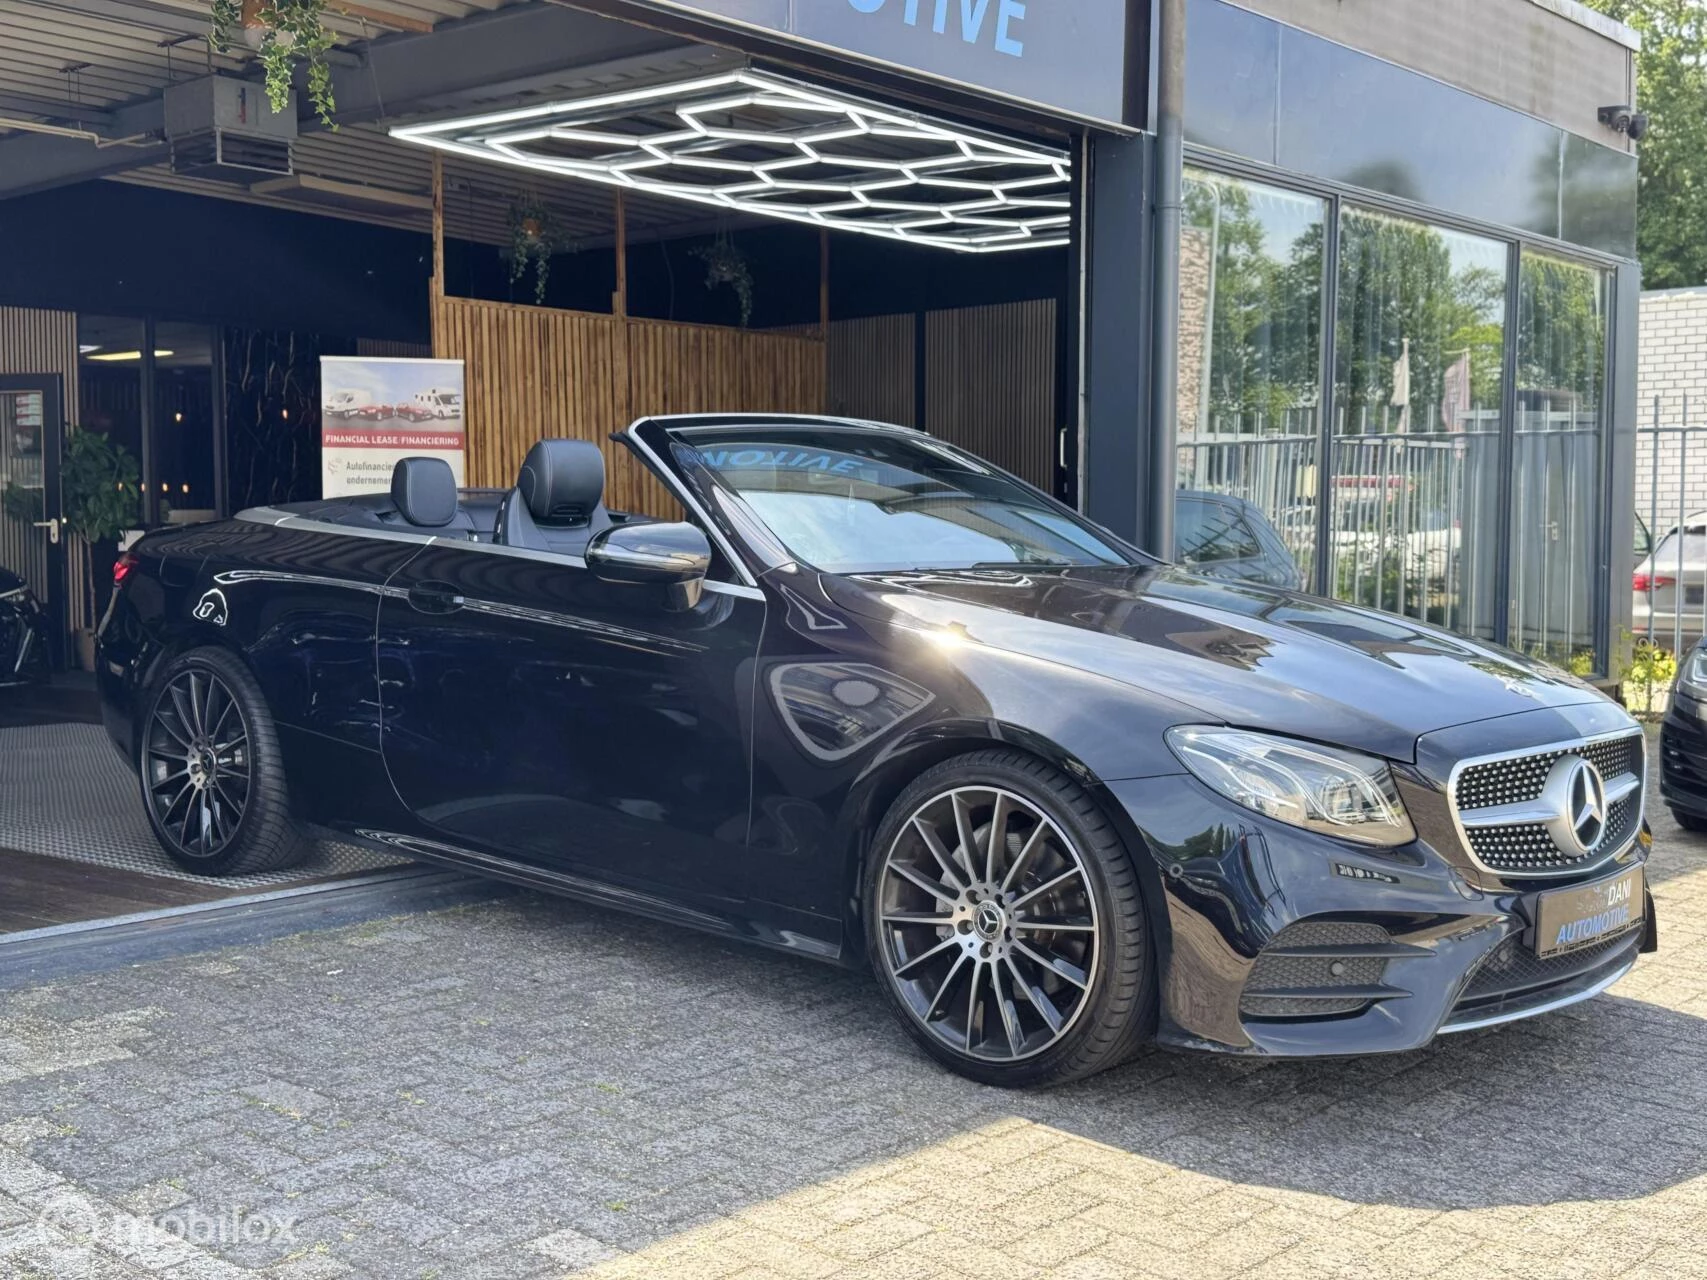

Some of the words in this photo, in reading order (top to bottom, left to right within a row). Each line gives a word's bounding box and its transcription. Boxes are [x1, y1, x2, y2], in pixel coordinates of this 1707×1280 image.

[325, 434, 368, 444] FINANCIAL
[371, 435, 398, 445] LEASE
[401, 436, 460, 446] FINANCIERING
[346, 461, 394, 471] Autofinancie
[1556, 904, 1630, 944] AUTOMOTIVE
